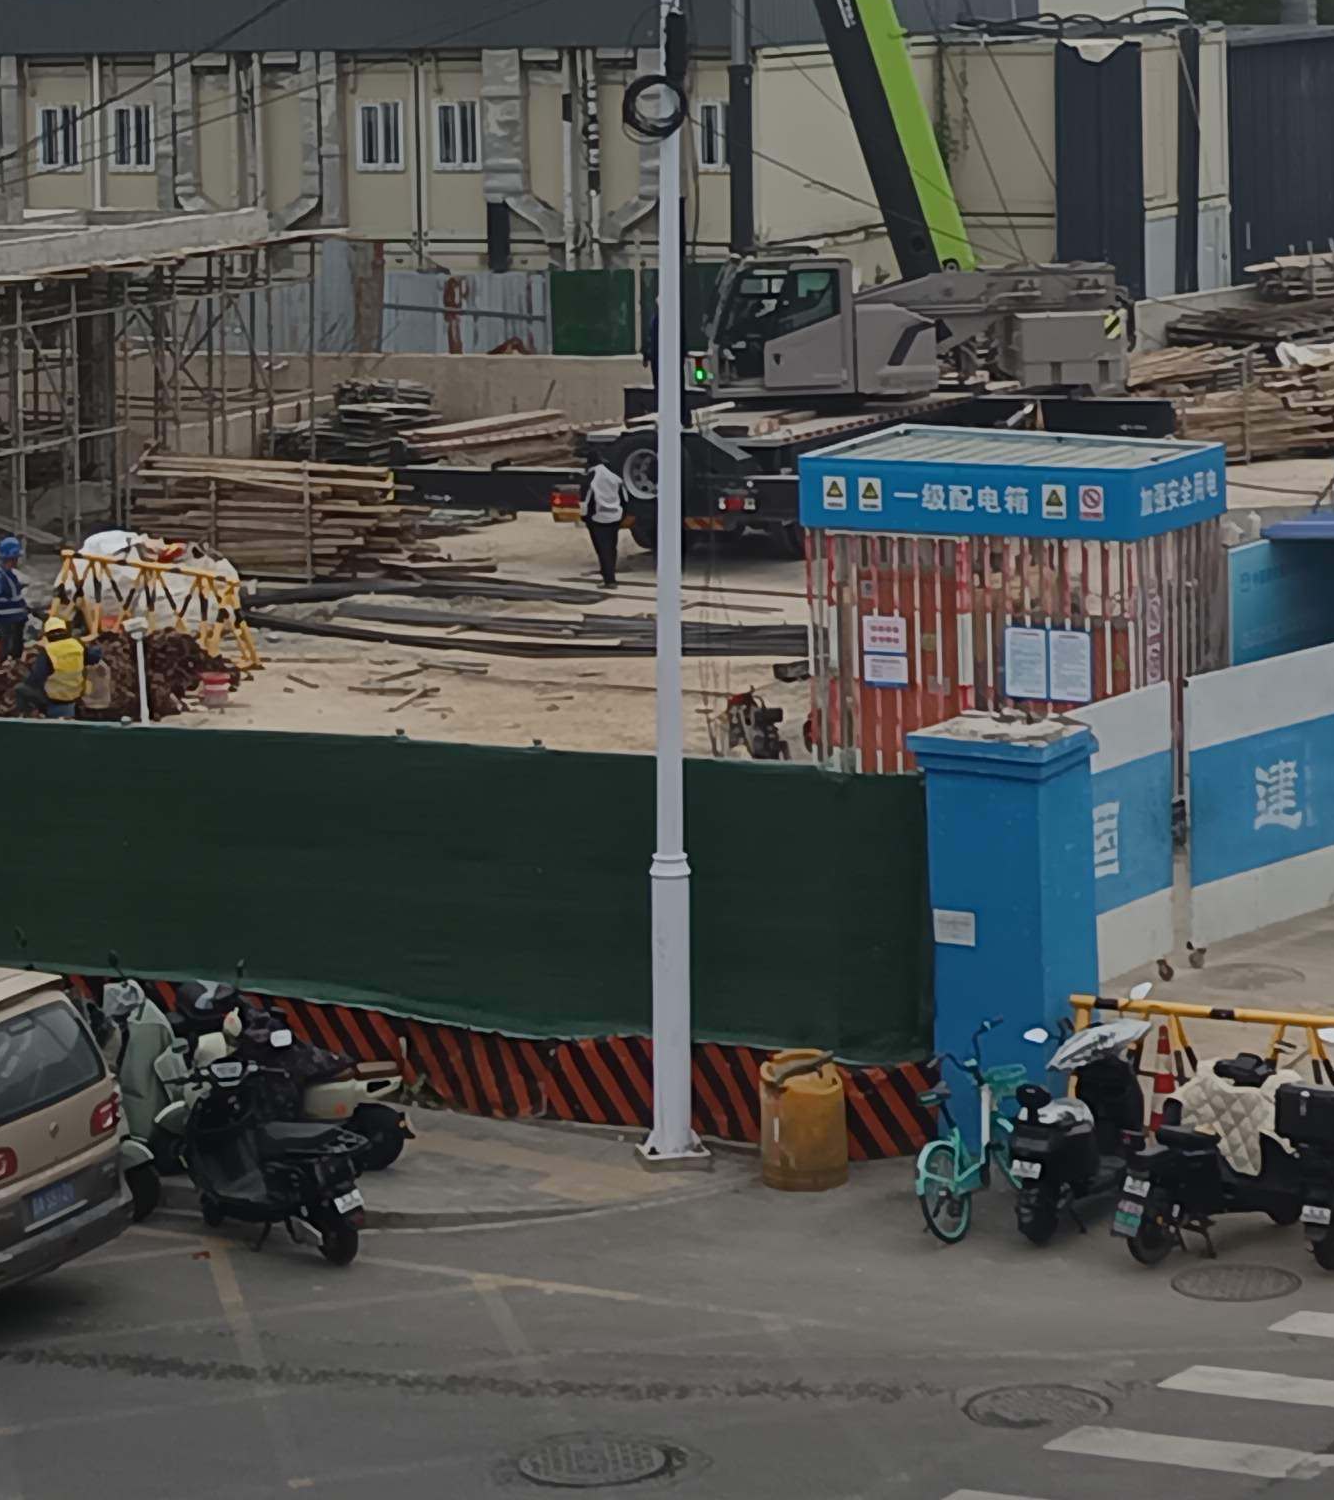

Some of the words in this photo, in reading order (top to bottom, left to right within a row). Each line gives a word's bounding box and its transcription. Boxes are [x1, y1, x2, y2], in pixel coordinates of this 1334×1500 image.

[893, 483, 1030, 516] 一级配电箱
[1140, 469, 1218, 517] 加强安全用电
